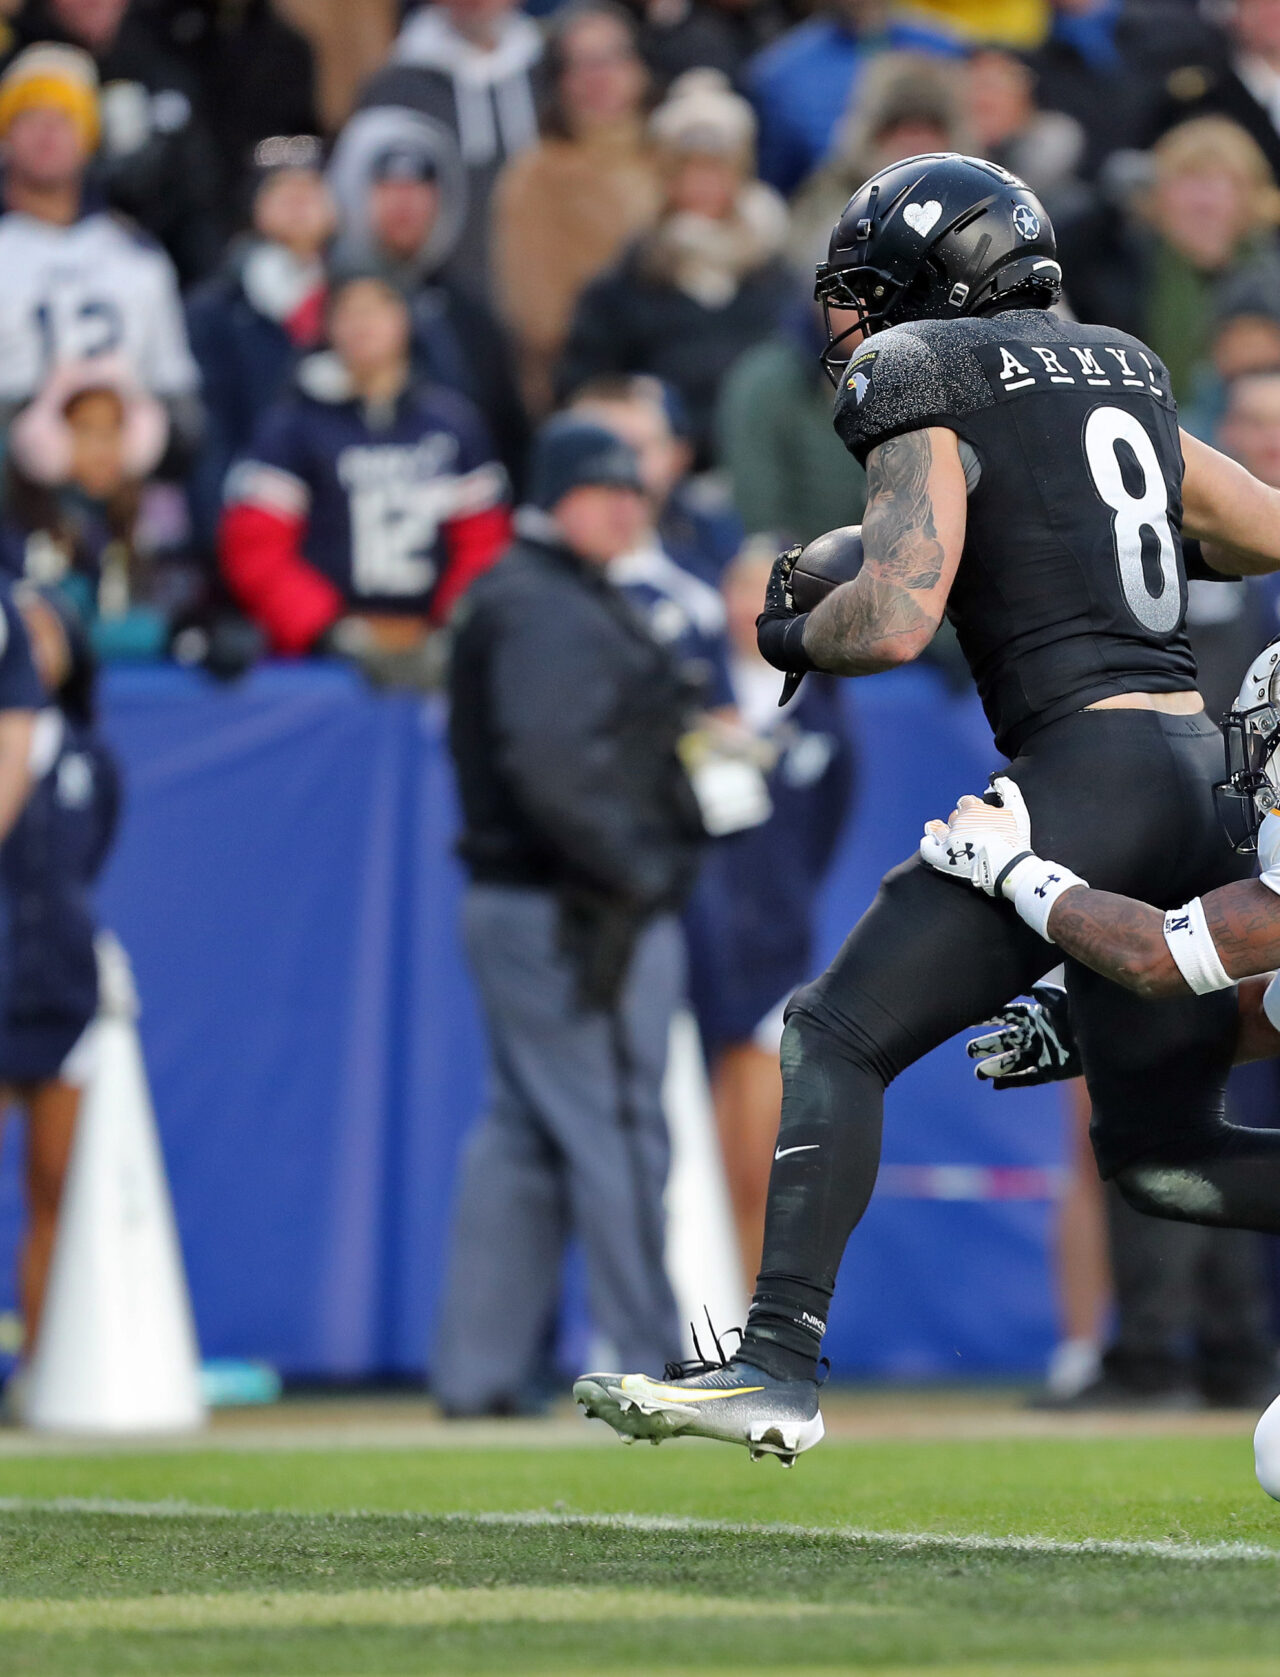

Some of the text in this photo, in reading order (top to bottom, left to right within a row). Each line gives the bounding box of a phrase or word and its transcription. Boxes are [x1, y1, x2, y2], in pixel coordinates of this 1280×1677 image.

[350, 488, 440, 597] 12
[1085, 406, 1181, 633] 8
[1171, 914, 1190, 931] N
[802, 1311, 826, 1334] NIKE
